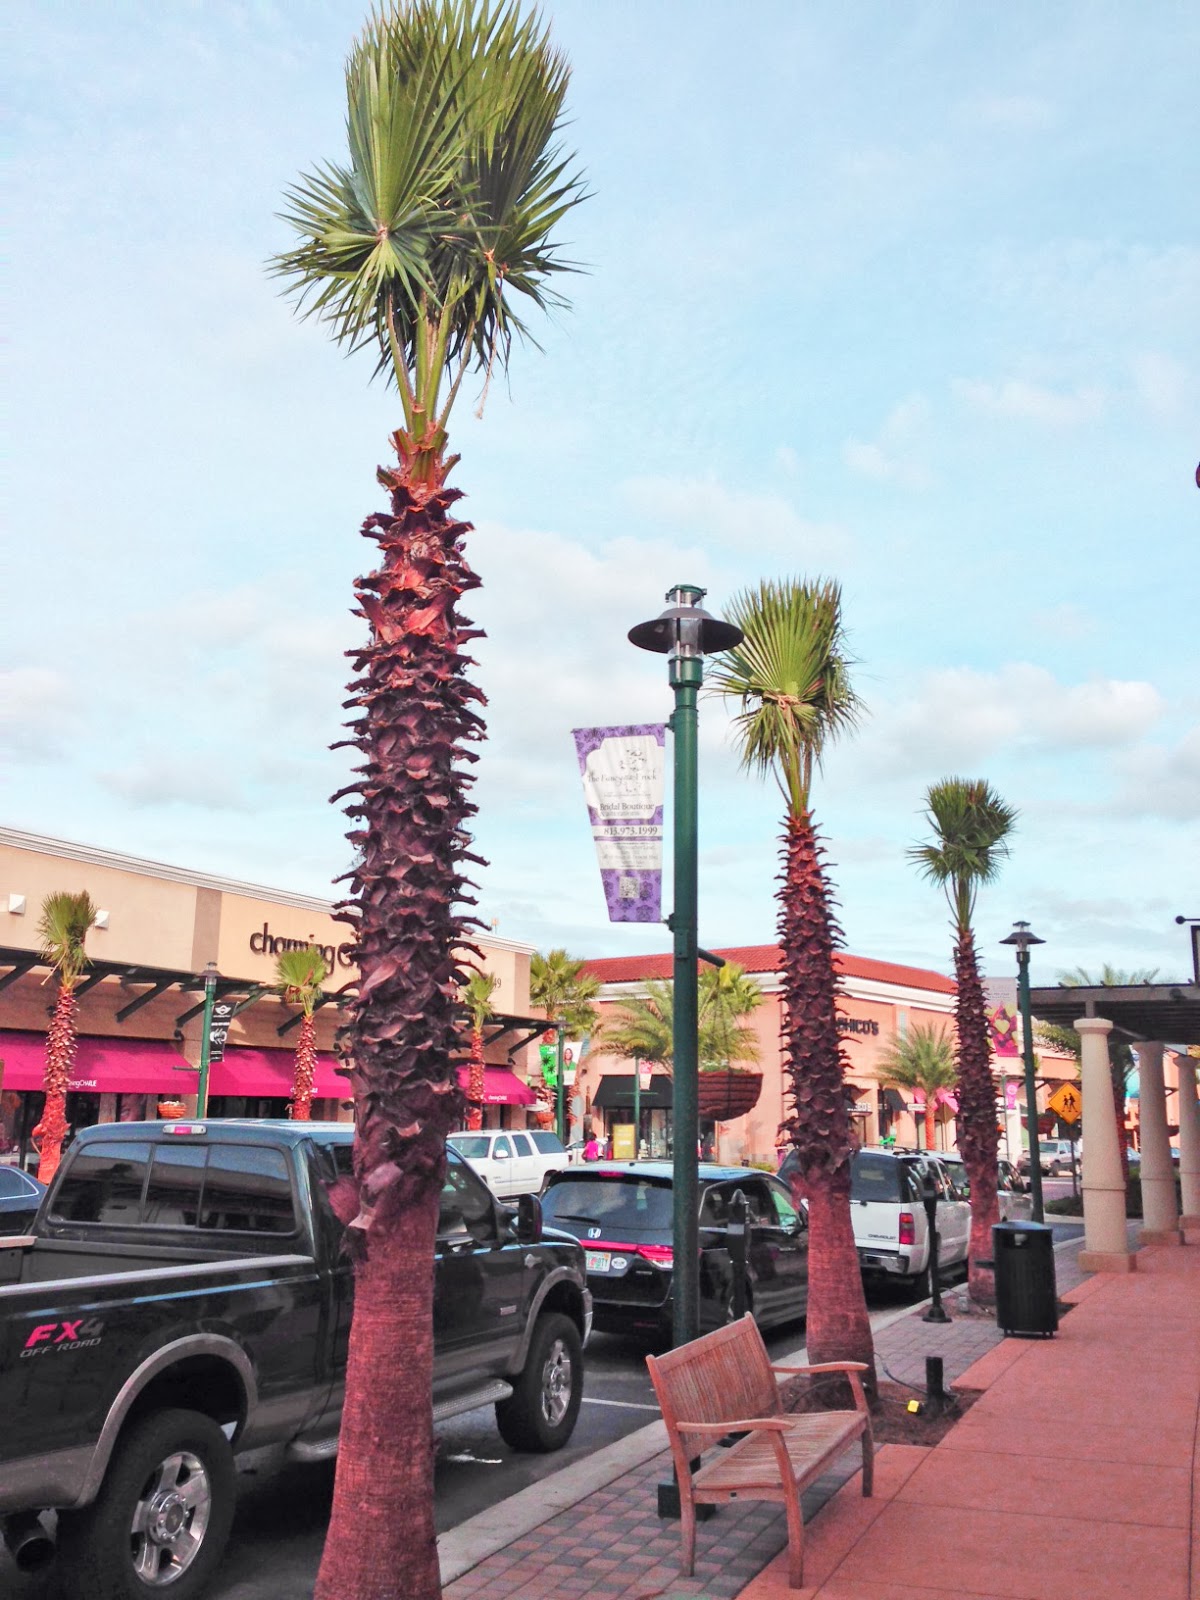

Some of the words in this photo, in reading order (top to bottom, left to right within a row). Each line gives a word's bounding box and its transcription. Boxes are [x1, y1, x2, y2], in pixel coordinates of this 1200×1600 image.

[600, 803, 620, 811] Bridal
[622, 802, 654, 811] Boutique
[604, 826, 658, 836] 813.973.1999
[249, 922, 336, 975] charmng
[25, 1317, 104, 1348] FX4
[20, 1346, 51, 1358] OFF
[57, 1338, 101, 1352] ROAD
